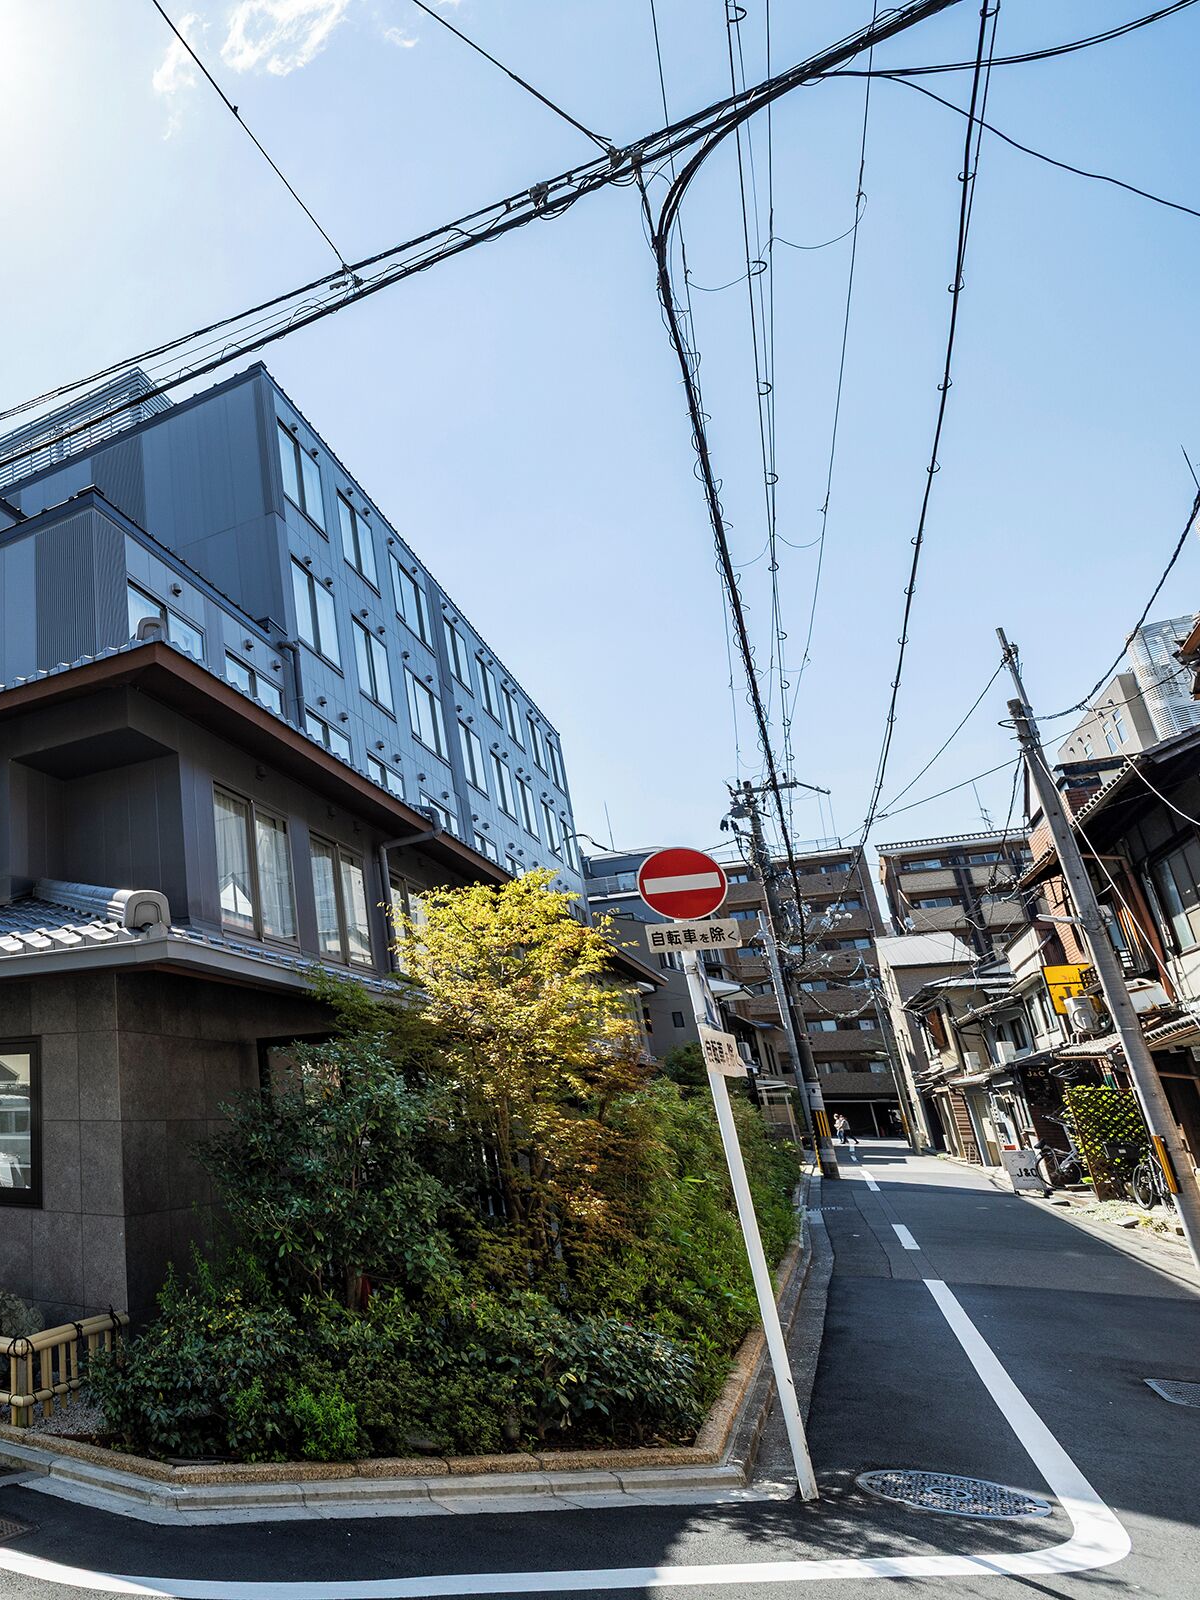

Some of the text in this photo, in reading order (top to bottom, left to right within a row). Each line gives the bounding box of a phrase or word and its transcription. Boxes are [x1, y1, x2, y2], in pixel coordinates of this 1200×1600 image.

[651, 926, 738, 947] 自転車を除く
